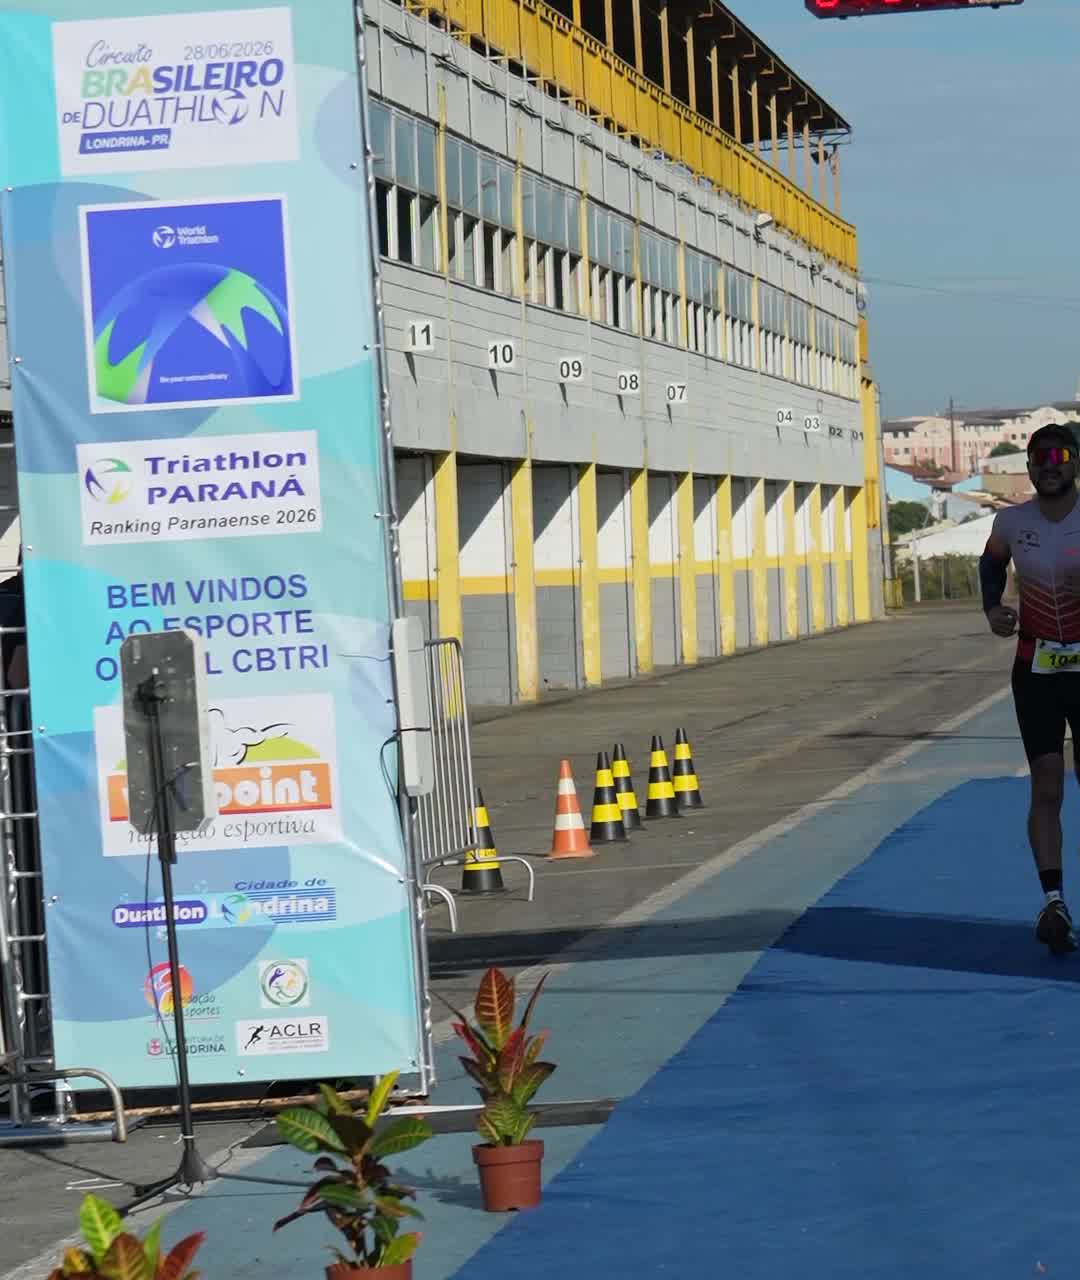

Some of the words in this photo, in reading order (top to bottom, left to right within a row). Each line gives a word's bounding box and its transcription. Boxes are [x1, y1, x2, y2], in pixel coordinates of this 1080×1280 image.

[86, 39, 153, 68] Circuito
[183, 40, 274, 62] 28/06/2026
[80, 58, 285, 99] BRASILEIRO
[62, 111, 81, 125] DE
[152, 133, 169, 146] PR
[409, 324, 432, 347] 11
[489, 344, 514, 364] 10
[560, 360, 583, 379] 09
[618, 374, 640, 391] 08
[667, 385, 686, 401] 07
[776, 410, 793, 423] 04
[804, 417, 820, 430] 03
[144, 450, 307, 476] Triathlon
[147, 474, 306, 505] PARANÁ
[90, 519, 161, 536] Ranking
[167, 513, 271, 532] Paranaense
[276, 508, 317, 525] 2026
[107, 581, 177, 609] BEM
[186, 573, 308, 604] VINDOS
[232, 644, 328, 673] CBTRI
[223, 816, 316, 843] esportiva
[235, 880, 299, 892] Cidade
[304, 877, 327, 888] de
[270, 1022, 322, 1038] ACLR
